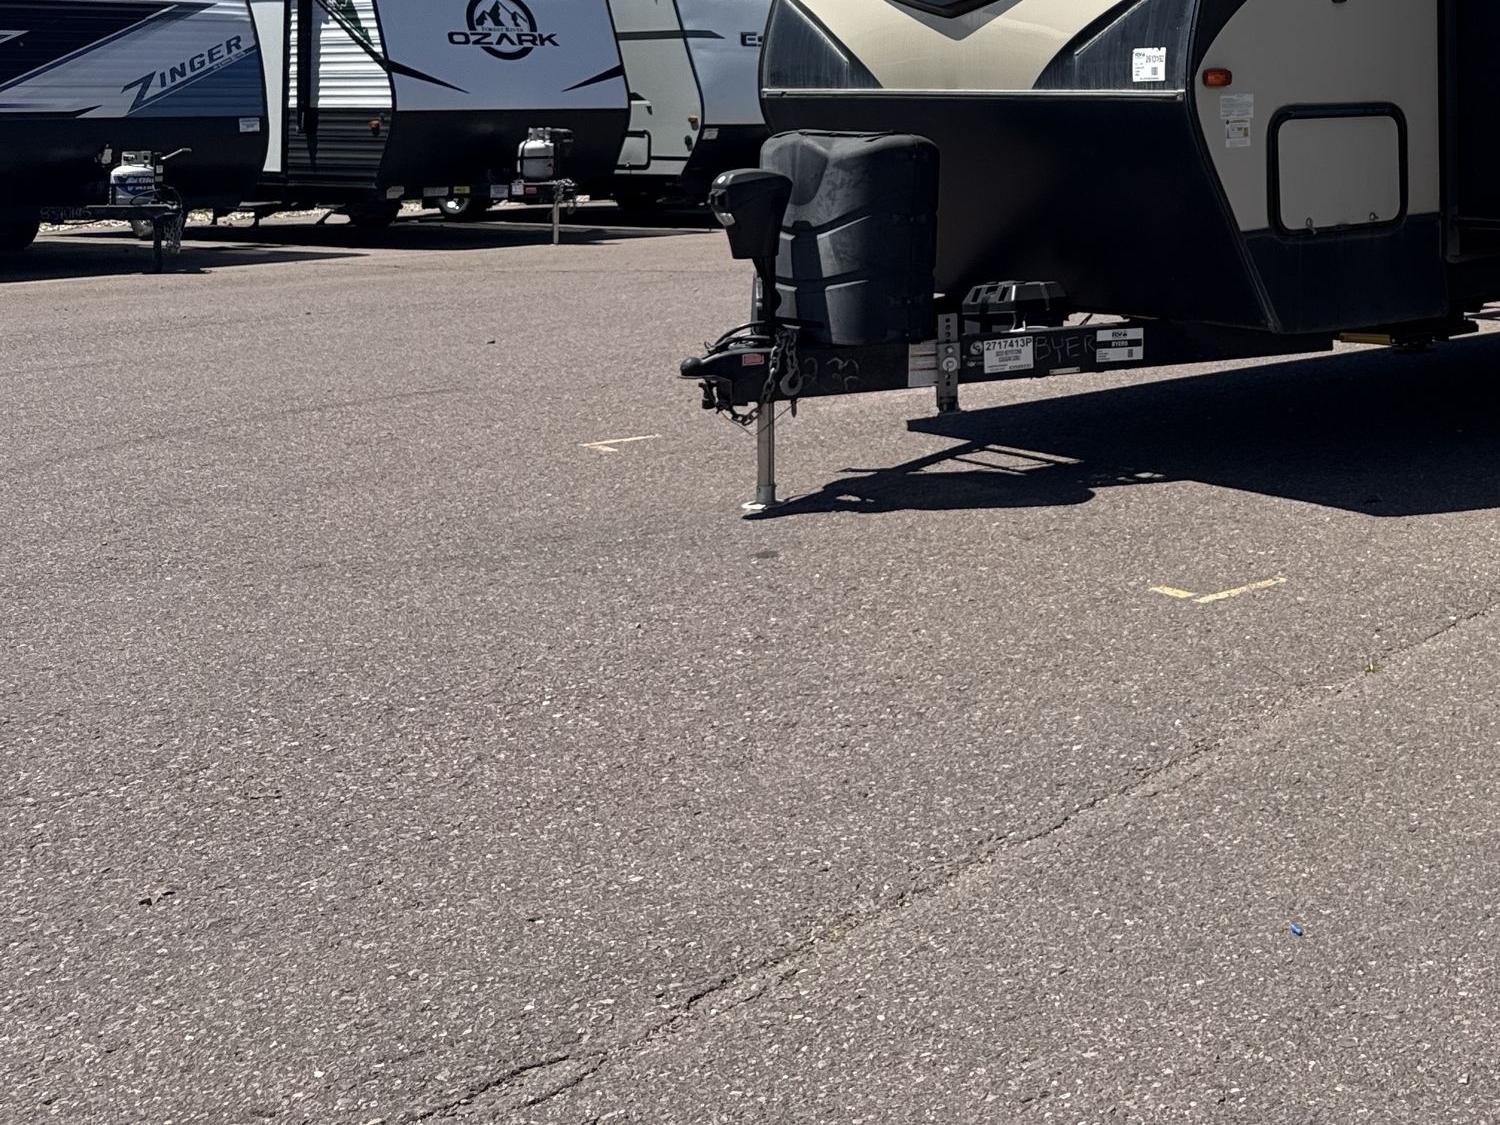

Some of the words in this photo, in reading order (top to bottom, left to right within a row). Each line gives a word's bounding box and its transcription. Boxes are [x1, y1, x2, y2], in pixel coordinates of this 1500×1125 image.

[447, 31, 560, 47] OZARK
[120, 35, 242, 113] ZINGER
[985, 337, 1032, 351] 2717413P
